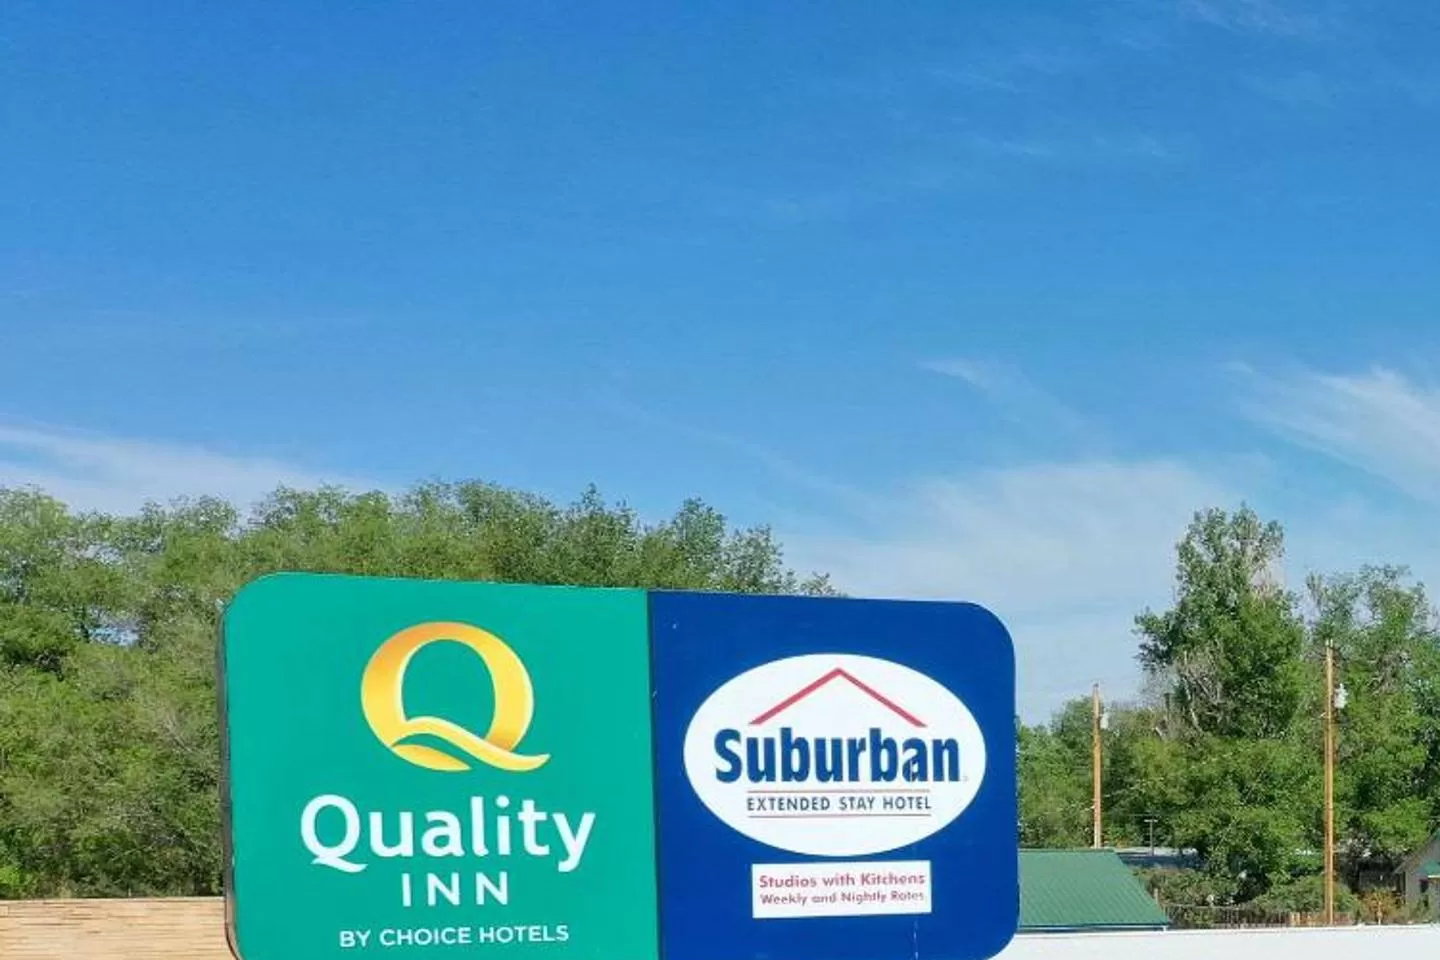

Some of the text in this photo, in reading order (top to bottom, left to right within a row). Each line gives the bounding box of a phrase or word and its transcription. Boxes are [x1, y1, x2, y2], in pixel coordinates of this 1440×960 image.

[361, 621, 551, 772] Q
[713, 727, 960, 784] Suburban
[747, 795, 932, 811] EXTENDED STAY HOTEL
[300, 794, 596, 873] Quality
[402, 872, 509, 907] INN
[759, 872, 926, 888] Studios with Kitchens
[760, 890, 925, 906] Weekly and Nightly Rates
[339, 925, 569, 948] BY CHOICE HOTELS
